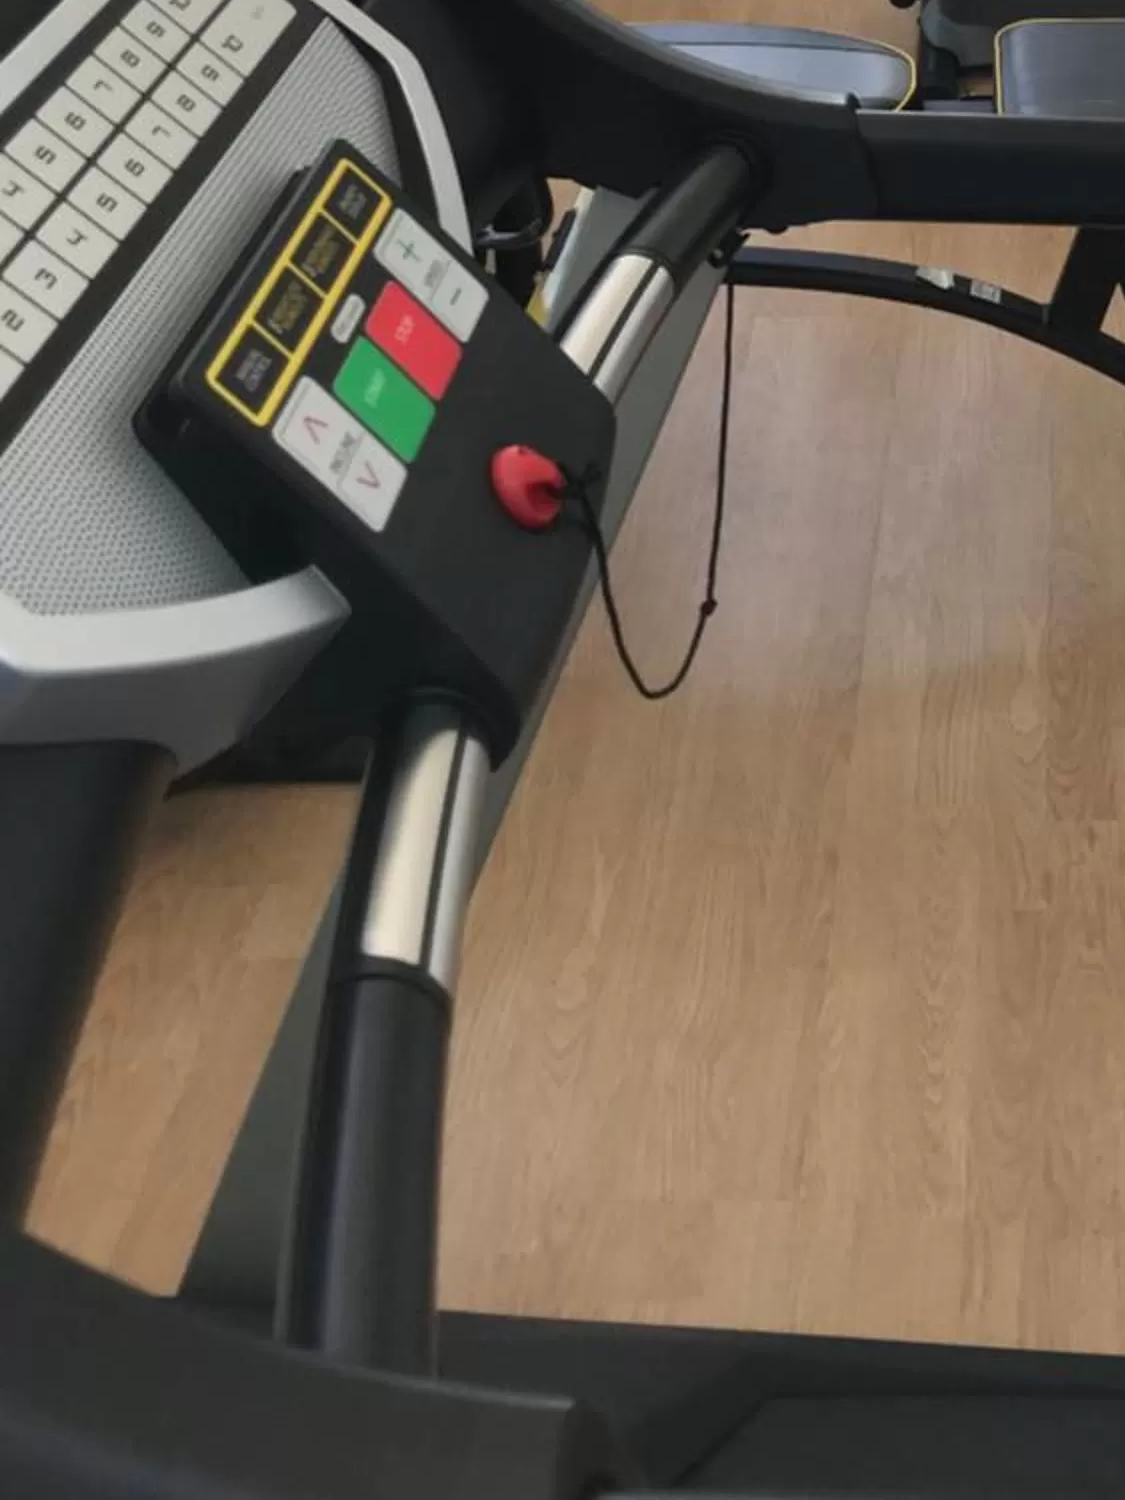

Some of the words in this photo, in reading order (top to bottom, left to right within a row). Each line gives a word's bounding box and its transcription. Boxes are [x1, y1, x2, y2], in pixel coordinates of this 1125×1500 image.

[34, 145, 57, 165] 5
[63, 111, 86, 131] 6
[119, 49, 141, 69] 8
[1, 309, 25, 332] 2
[34, 267, 58, 290] 3
[96, 193, 119, 213] 5
[124, 158, 145, 178] 6
[176, 93, 197, 113] 8
